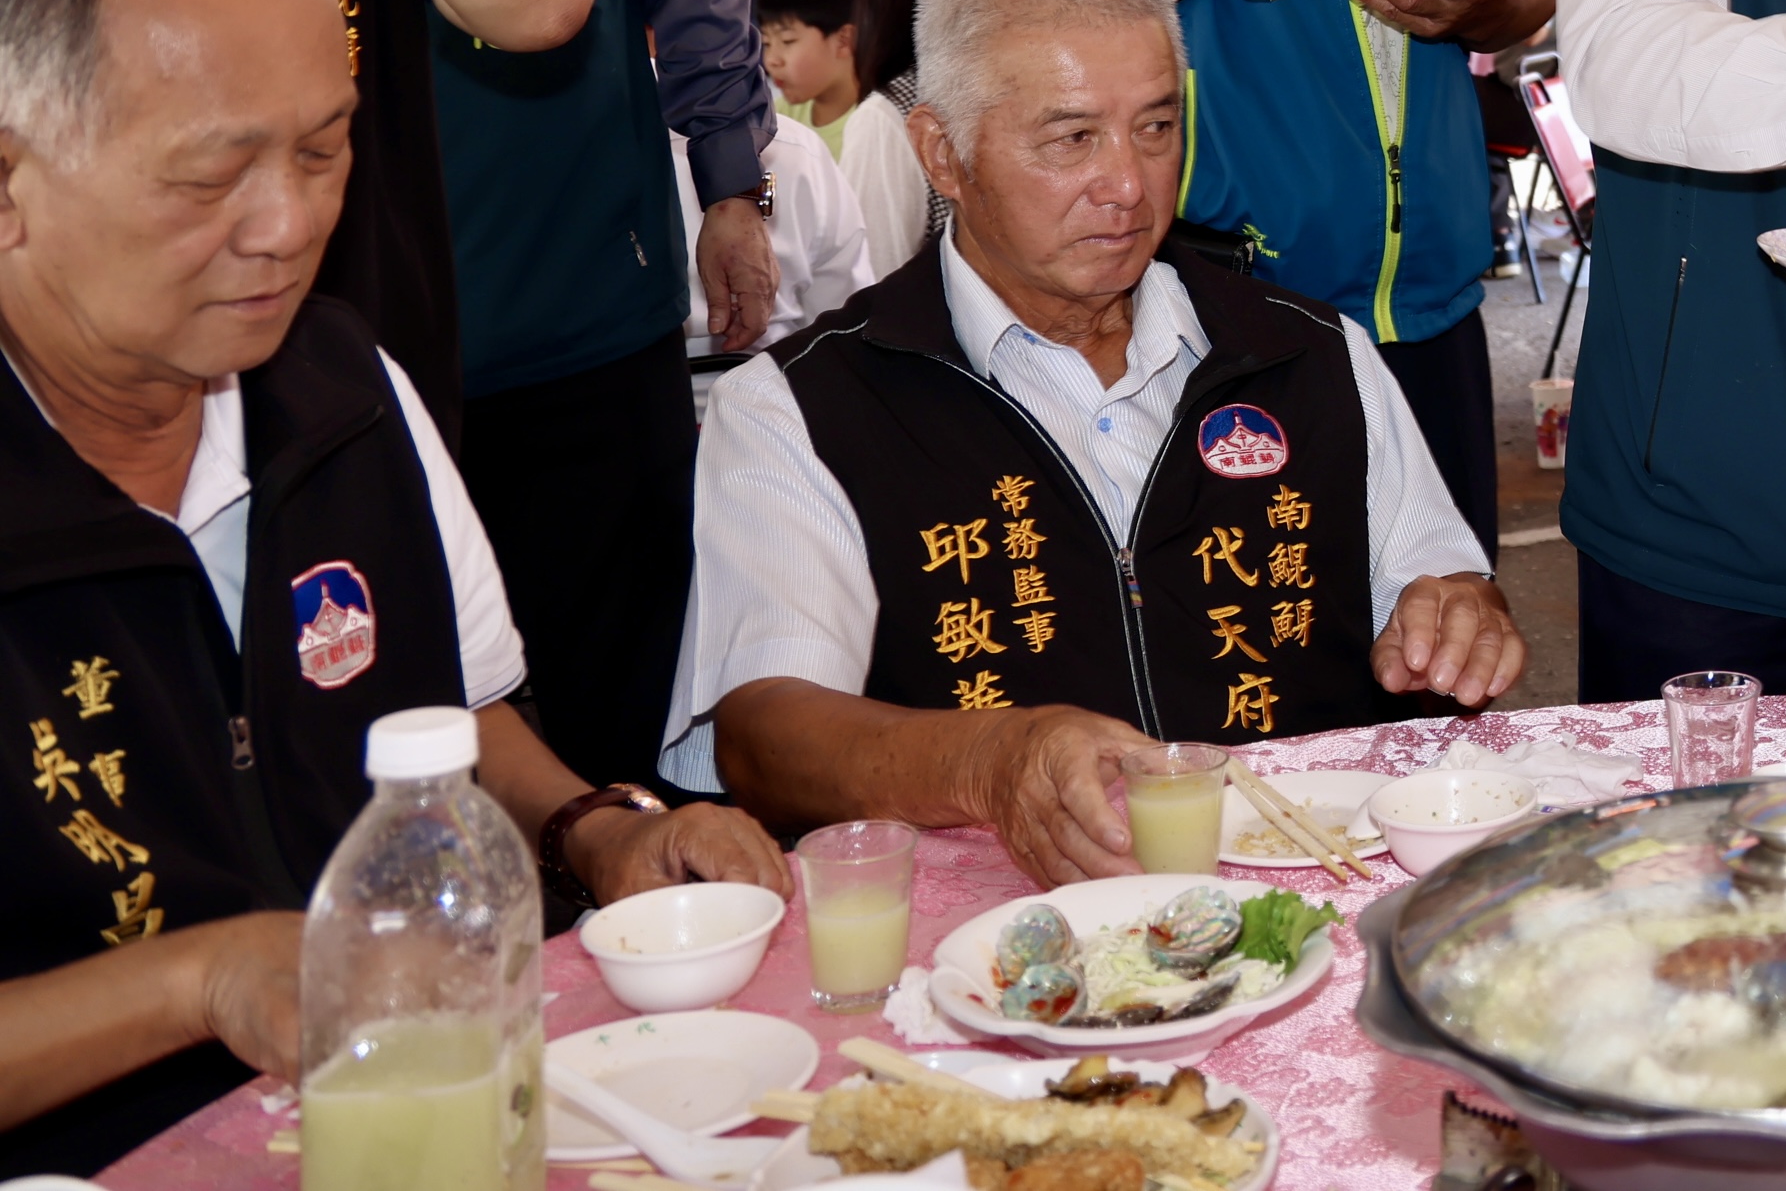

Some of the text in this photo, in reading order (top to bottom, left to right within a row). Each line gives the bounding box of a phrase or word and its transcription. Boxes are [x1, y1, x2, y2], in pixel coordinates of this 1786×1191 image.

[992, 475, 1057, 654] 常務監事
[1192, 527, 1280, 733] 代天府
[1266, 484, 1317, 648] 南鯤鯓
[62, 656, 127, 807] 董事
